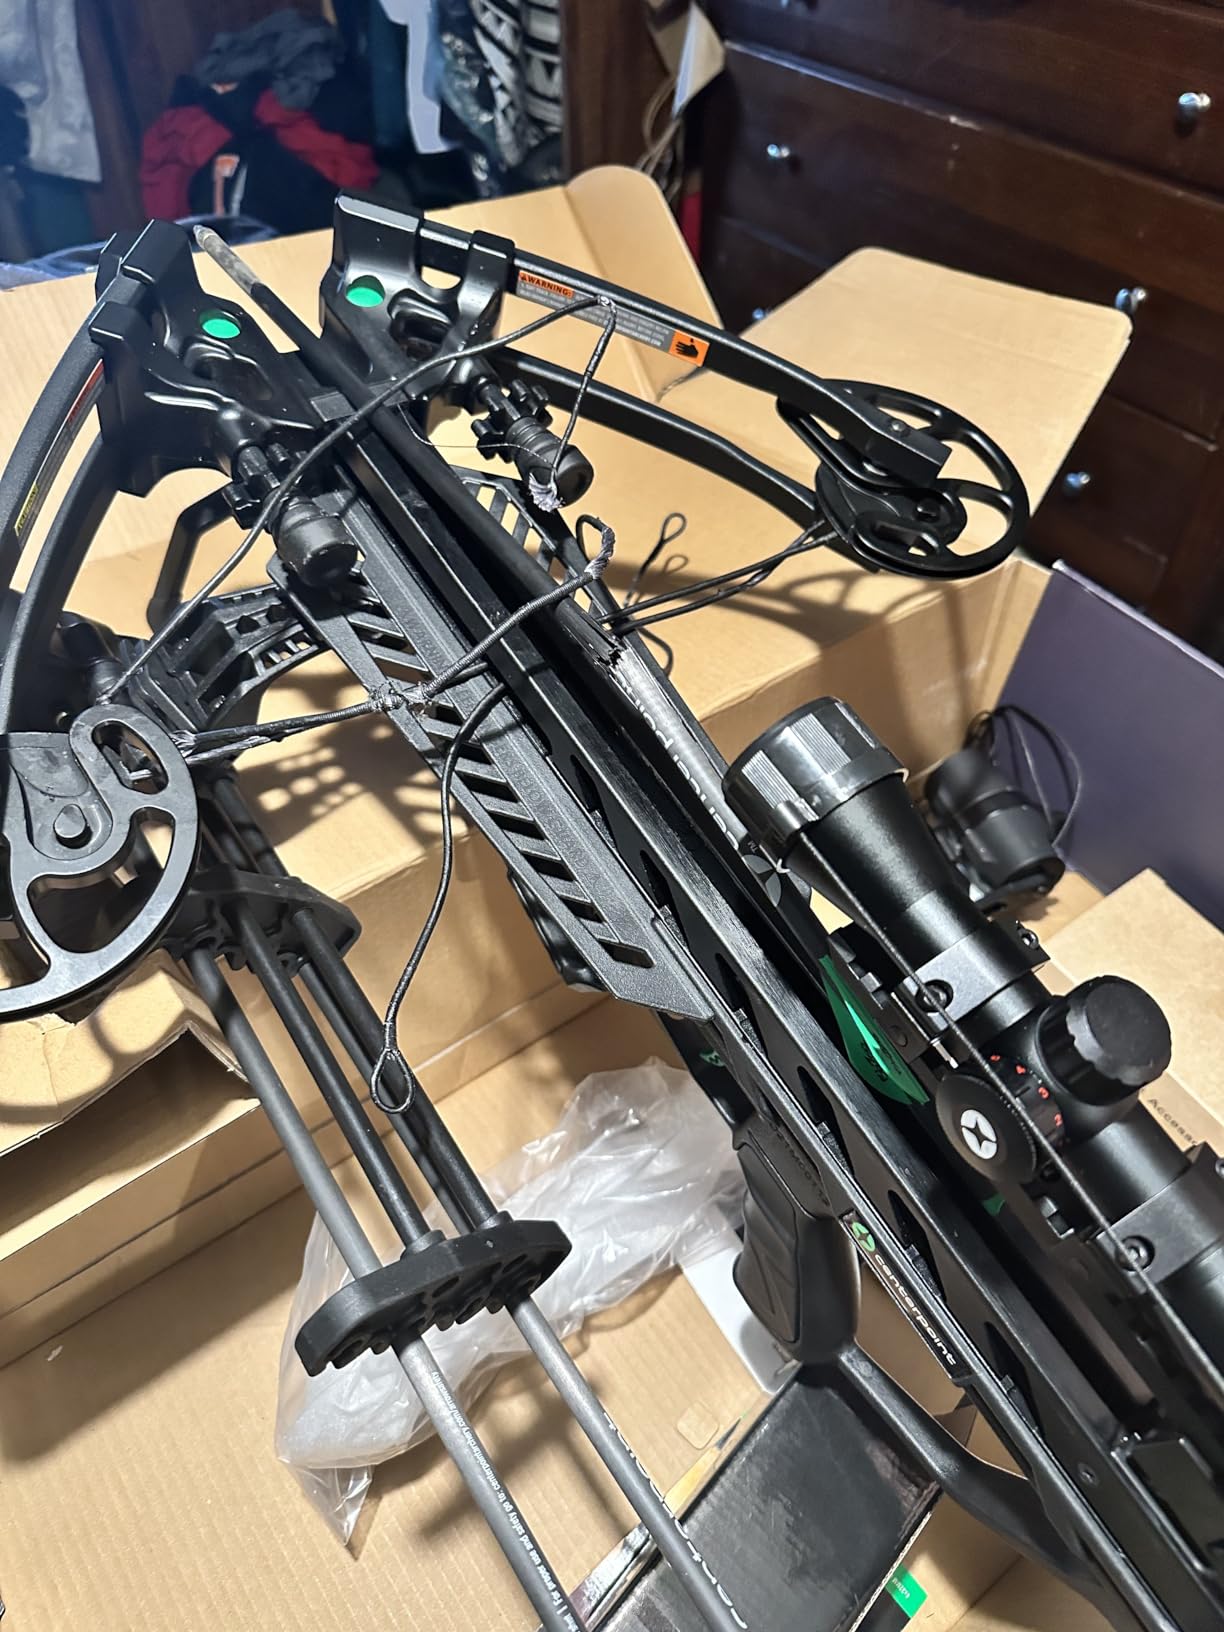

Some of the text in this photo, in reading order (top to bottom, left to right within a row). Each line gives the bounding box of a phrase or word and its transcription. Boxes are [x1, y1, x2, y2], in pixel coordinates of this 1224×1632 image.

[874, 1253, 958, 1367] centerpoint
[497, 1489, 507, 1503] to:
[502, 1500, 514, 1513] go
[508, 1511, 525, 1536] safety
[520, 1534, 534, 1551] and
[529, 1549, 541, 1566] use
